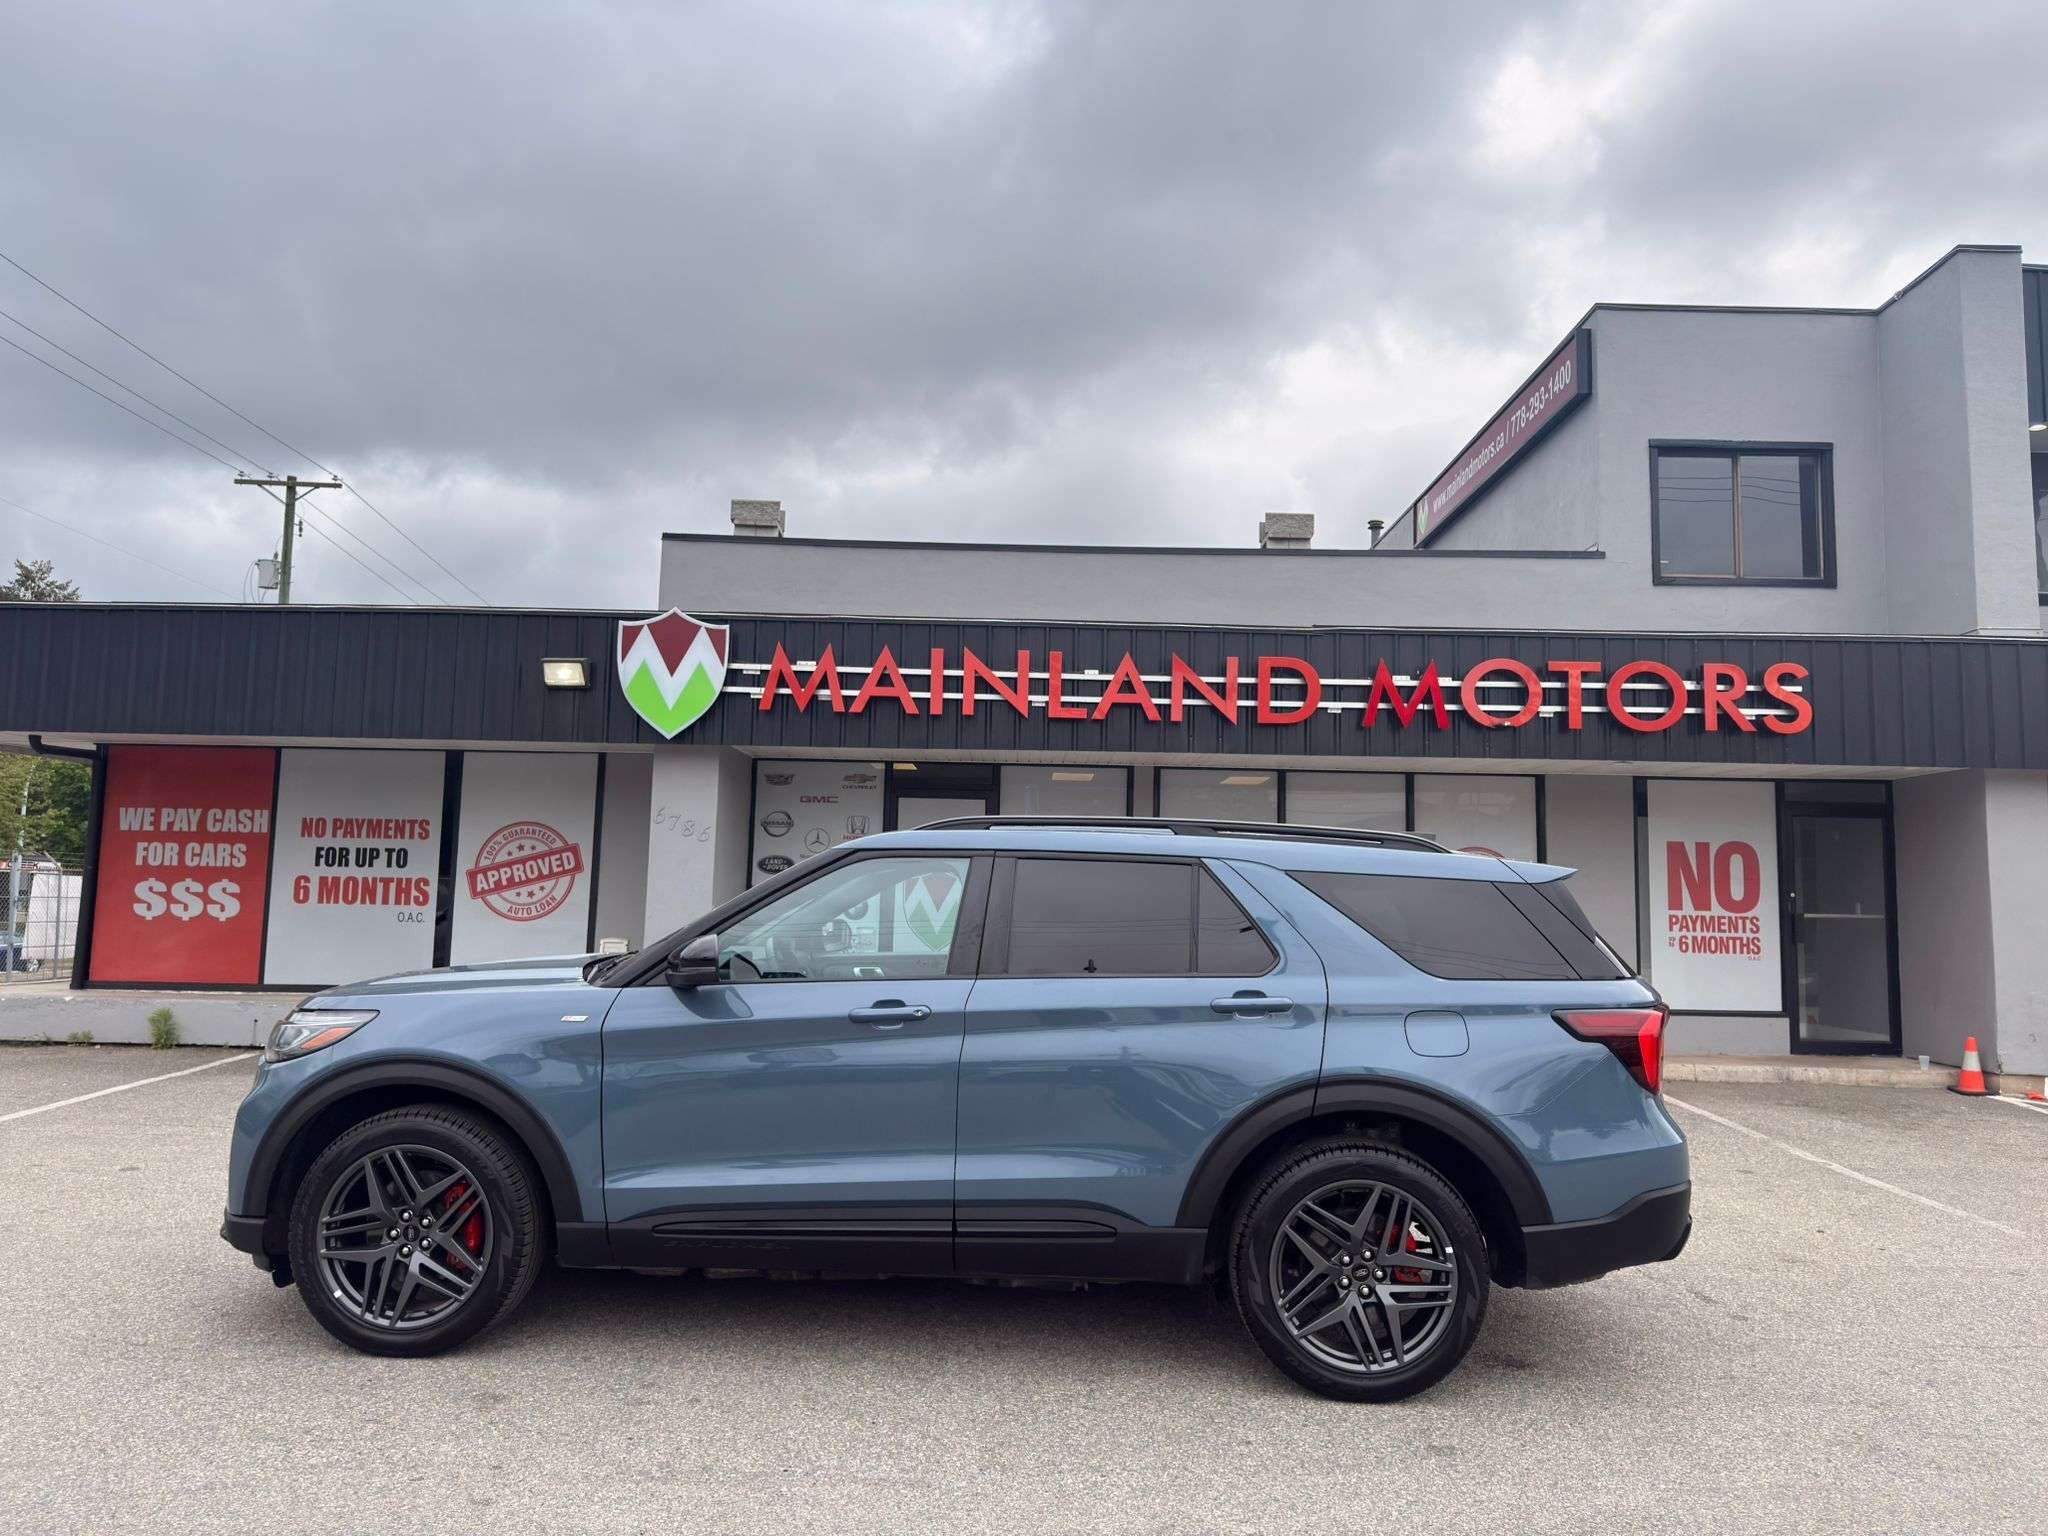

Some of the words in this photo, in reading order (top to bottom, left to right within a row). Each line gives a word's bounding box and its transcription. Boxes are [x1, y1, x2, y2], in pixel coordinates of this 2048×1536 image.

[1433, 431, 1504, 513] www.mainlandmotors.ca
[1511, 360, 1571, 438] 778-293-1400
[759, 641, 1322, 725] MAINLAND
[1362, 658, 1813, 734] MOTORS
[800, 795, 839, 804] GMC
[119, 807, 155, 832] WE
[160, 808, 203, 832] PAY
[206, 809, 270, 833] CASH
[301, 817, 328, 838] NO
[331, 817, 431, 840] PAYMENTS
[502, 827, 558, 845] GUARANTEED
[135, 842, 179, 866] FOR
[185, 842, 247, 868] CARS
[314, 846, 350, 867] FOR
[354, 847, 380, 868] UP
[384, 848, 409, 869] TO
[476, 851, 576, 893] APPROVED
[1666, 840, 1760, 914] NO
[133, 877, 241, 922] $$$
[293, 874, 311, 905] 6
[317, 875, 431, 907] MONTHS
[397, 911, 425, 923] O.A.C.
[507, 904, 533, 916] AUTO
[535, 894, 558, 914] LOAN
[1668, 914, 1760, 934] PAYMENTS
[1679, 935, 1689, 954] 6
[1691, 935, 1761, 955] MONTHS
